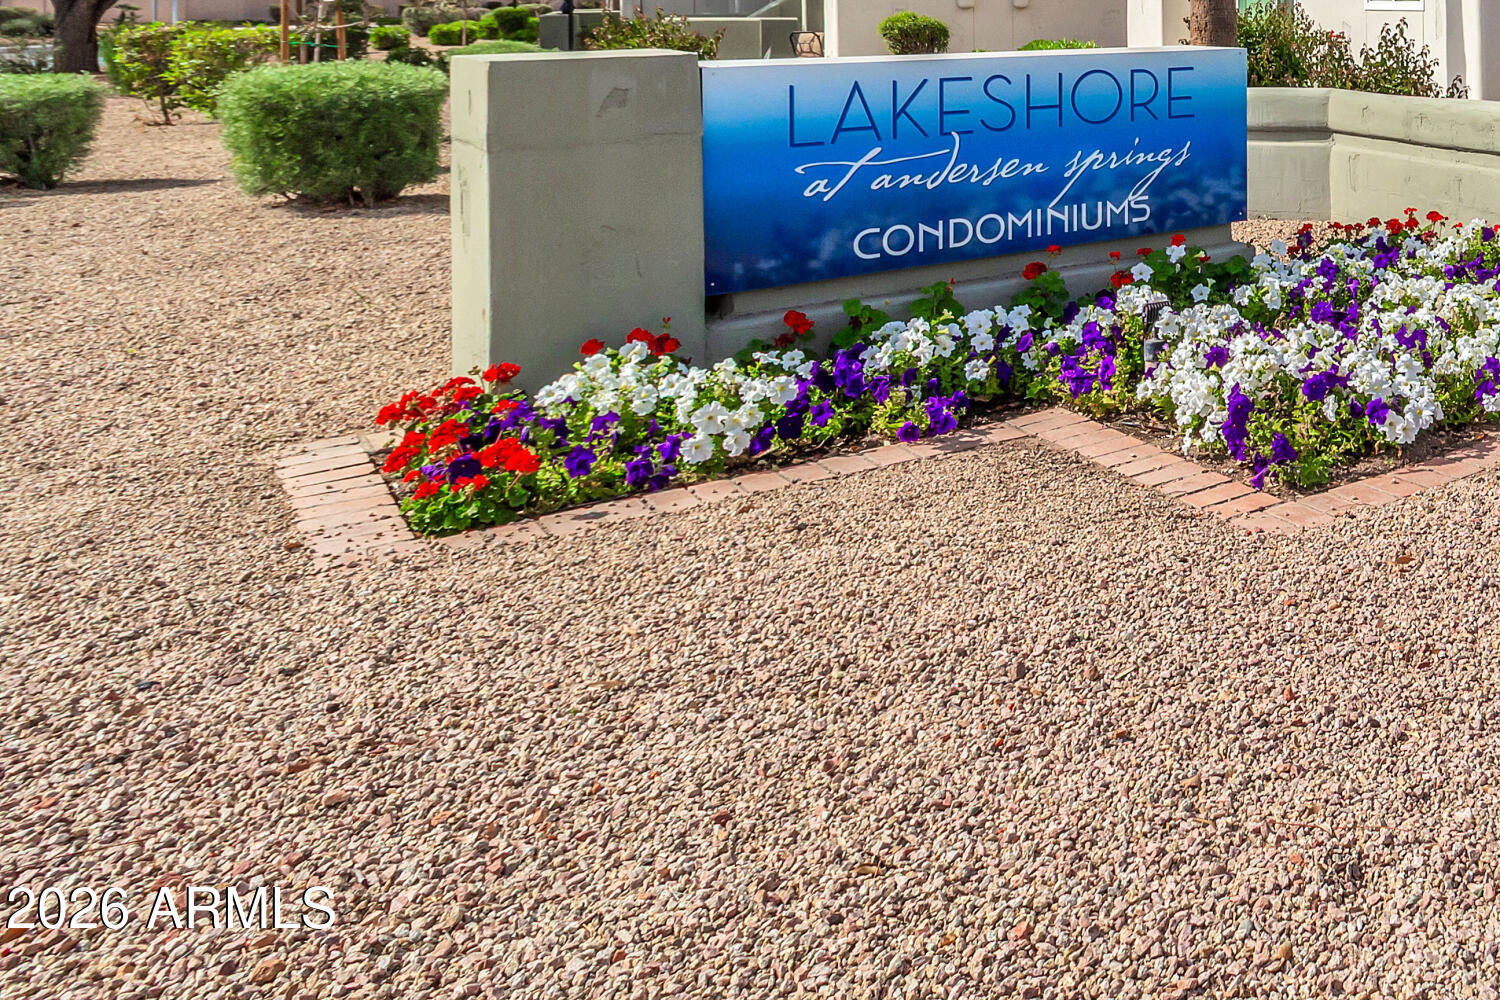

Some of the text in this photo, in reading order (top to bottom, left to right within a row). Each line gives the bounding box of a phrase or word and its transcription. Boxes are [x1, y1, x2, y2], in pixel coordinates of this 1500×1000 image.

[788, 66, 1195, 148] LAKESHORE
[795, 131, 1191, 208] at andersen springs
[853, 195, 1151, 260] CONDOMINIUMS
